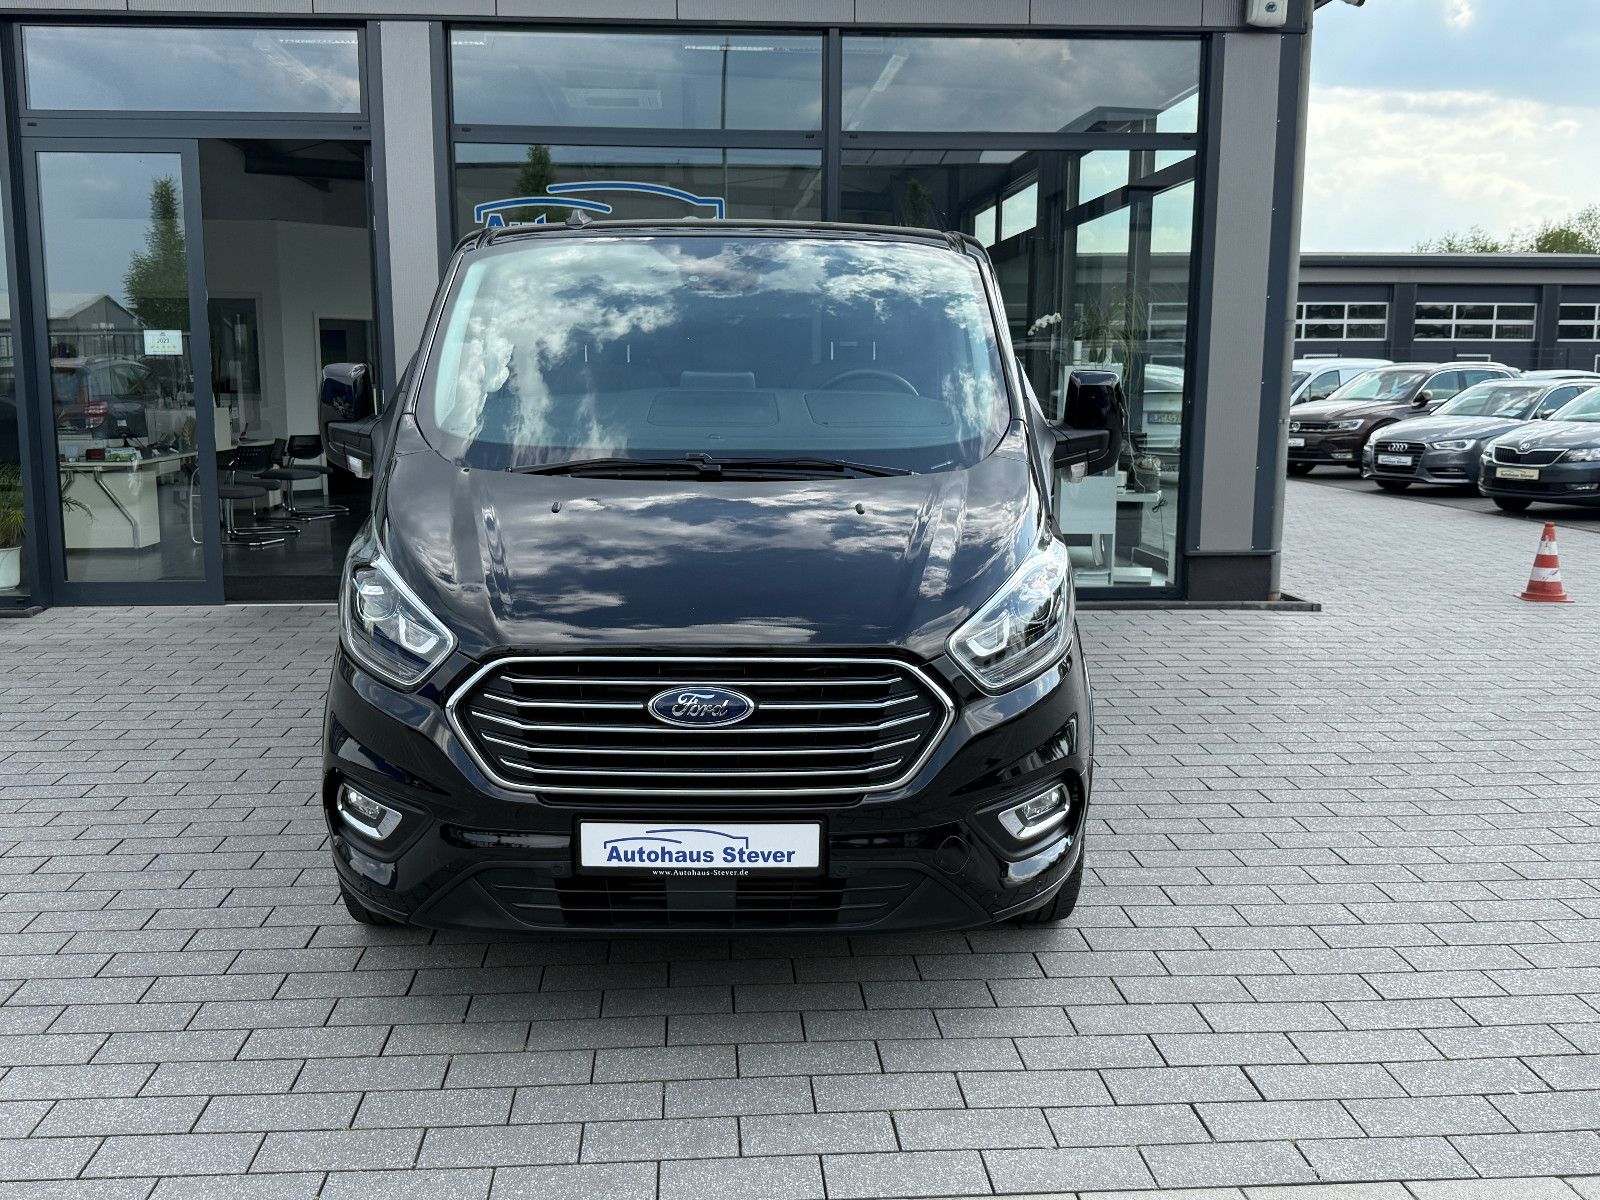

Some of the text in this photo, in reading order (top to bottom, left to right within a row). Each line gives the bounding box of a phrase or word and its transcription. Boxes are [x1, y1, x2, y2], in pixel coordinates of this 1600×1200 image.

[671, 693, 730, 717] Ford
[606, 845, 796, 864] Autohaus Stever
[652, 868, 749, 877] www.Autohaus-Stever.de
